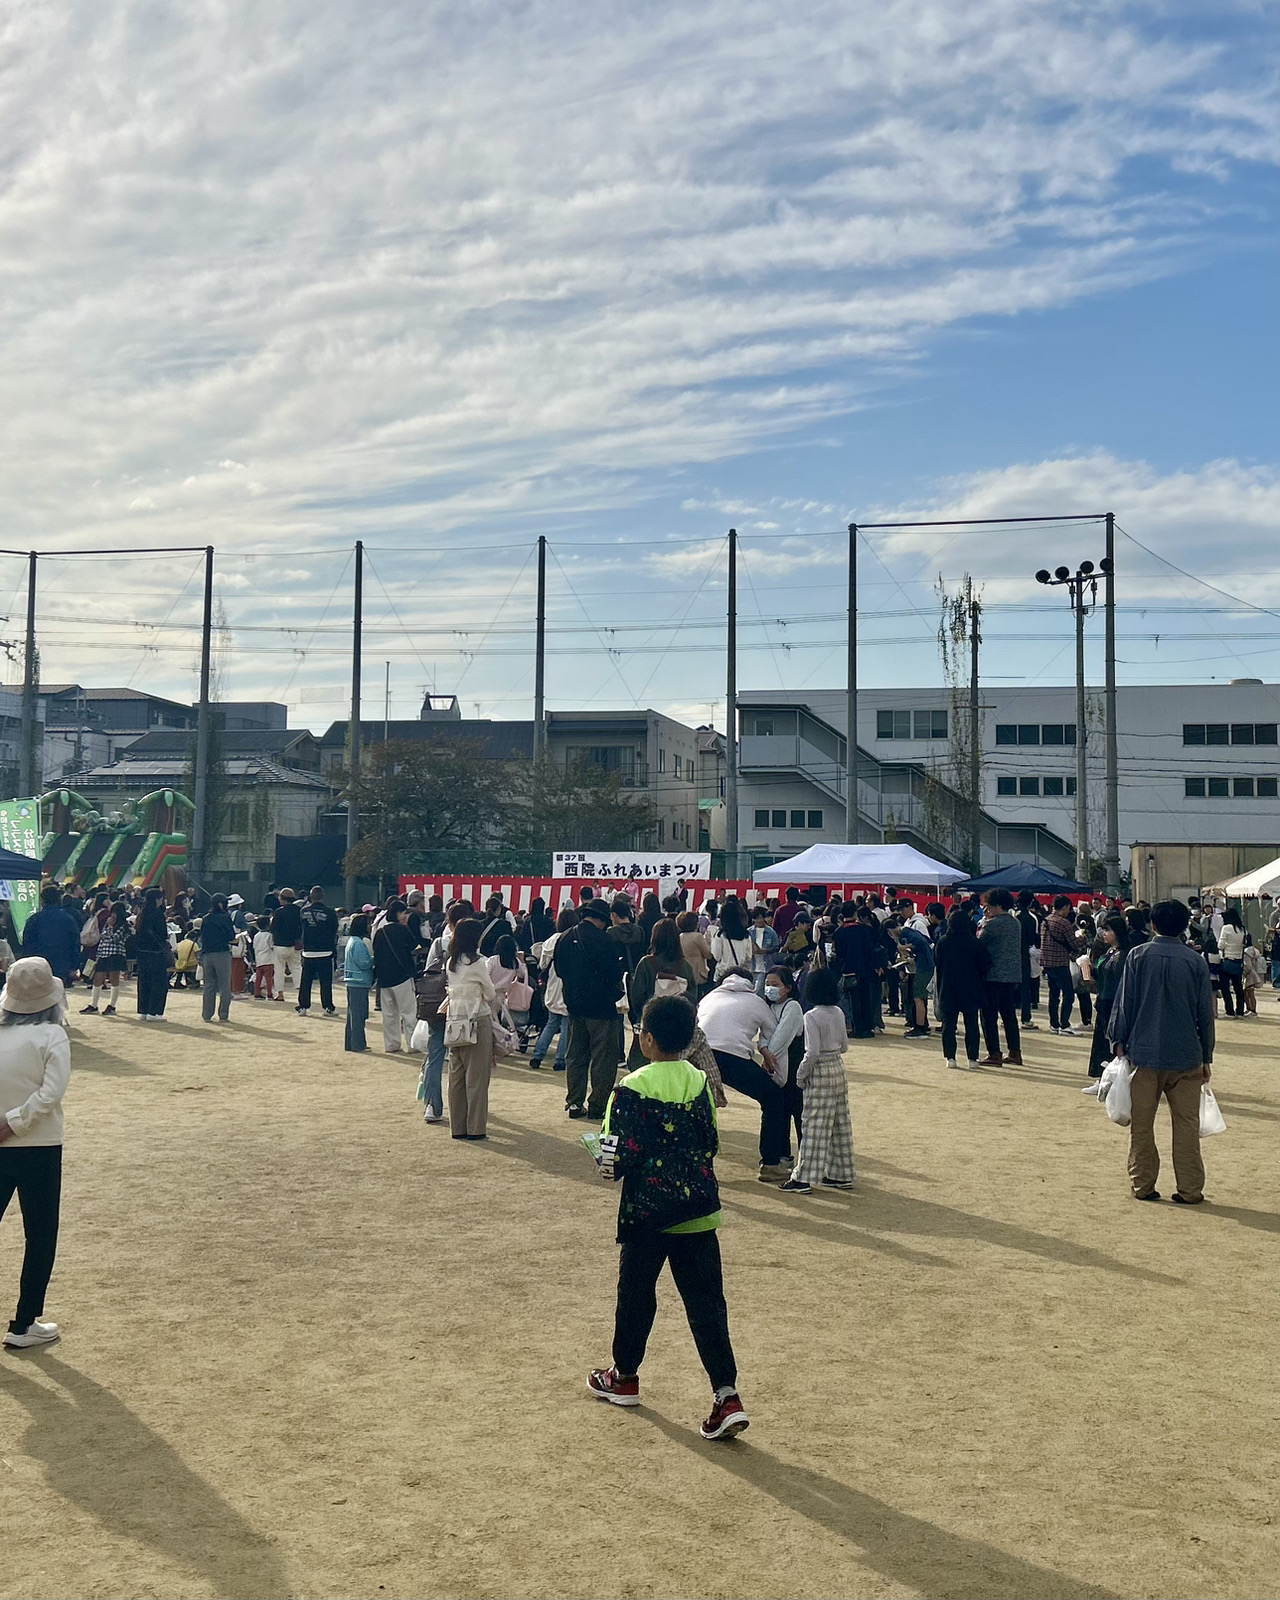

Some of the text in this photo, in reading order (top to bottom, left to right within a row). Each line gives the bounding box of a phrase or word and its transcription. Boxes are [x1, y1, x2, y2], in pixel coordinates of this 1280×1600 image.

[564, 862, 700, 877] 西院ふれあいまつり
